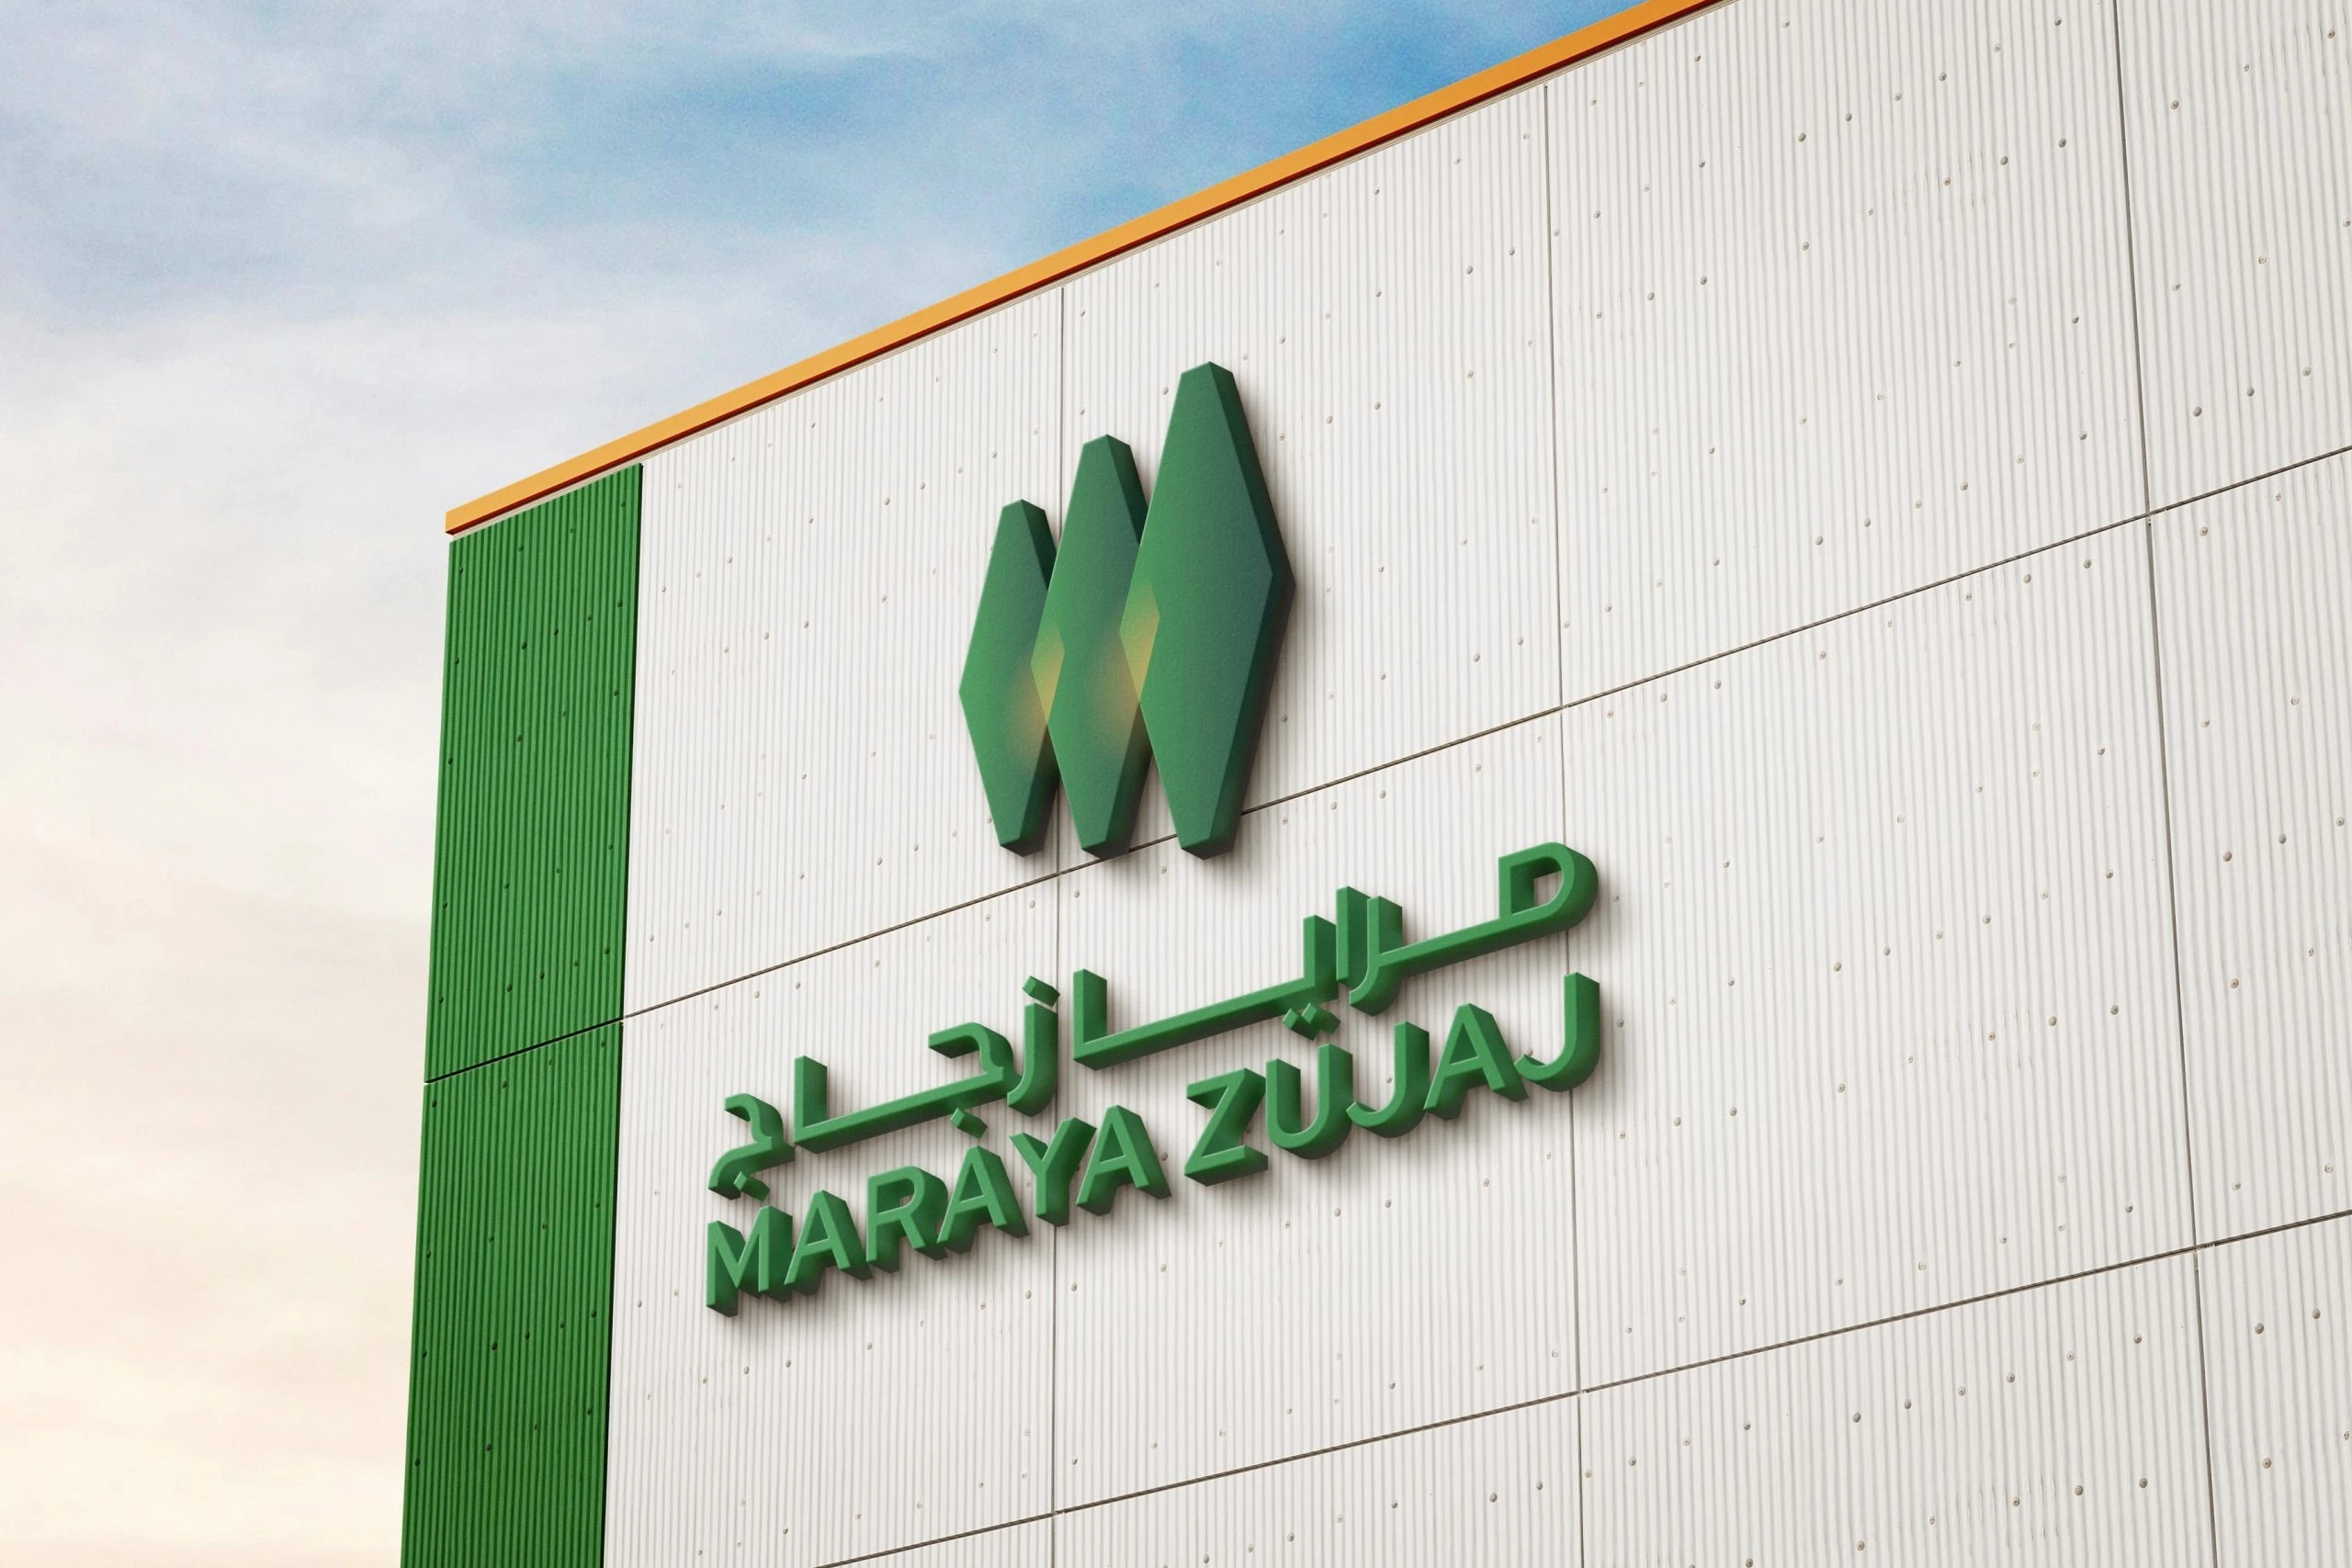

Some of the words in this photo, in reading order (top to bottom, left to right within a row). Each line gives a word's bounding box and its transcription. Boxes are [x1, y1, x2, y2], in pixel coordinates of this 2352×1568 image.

[1073, 841, 1599, 1071] مرايا
[706, 1104, 1172, 1317] MARAYA
[1184, 972, 1600, 1187] ZUJAJ
[707, 975, 1060, 1201] زجاج
